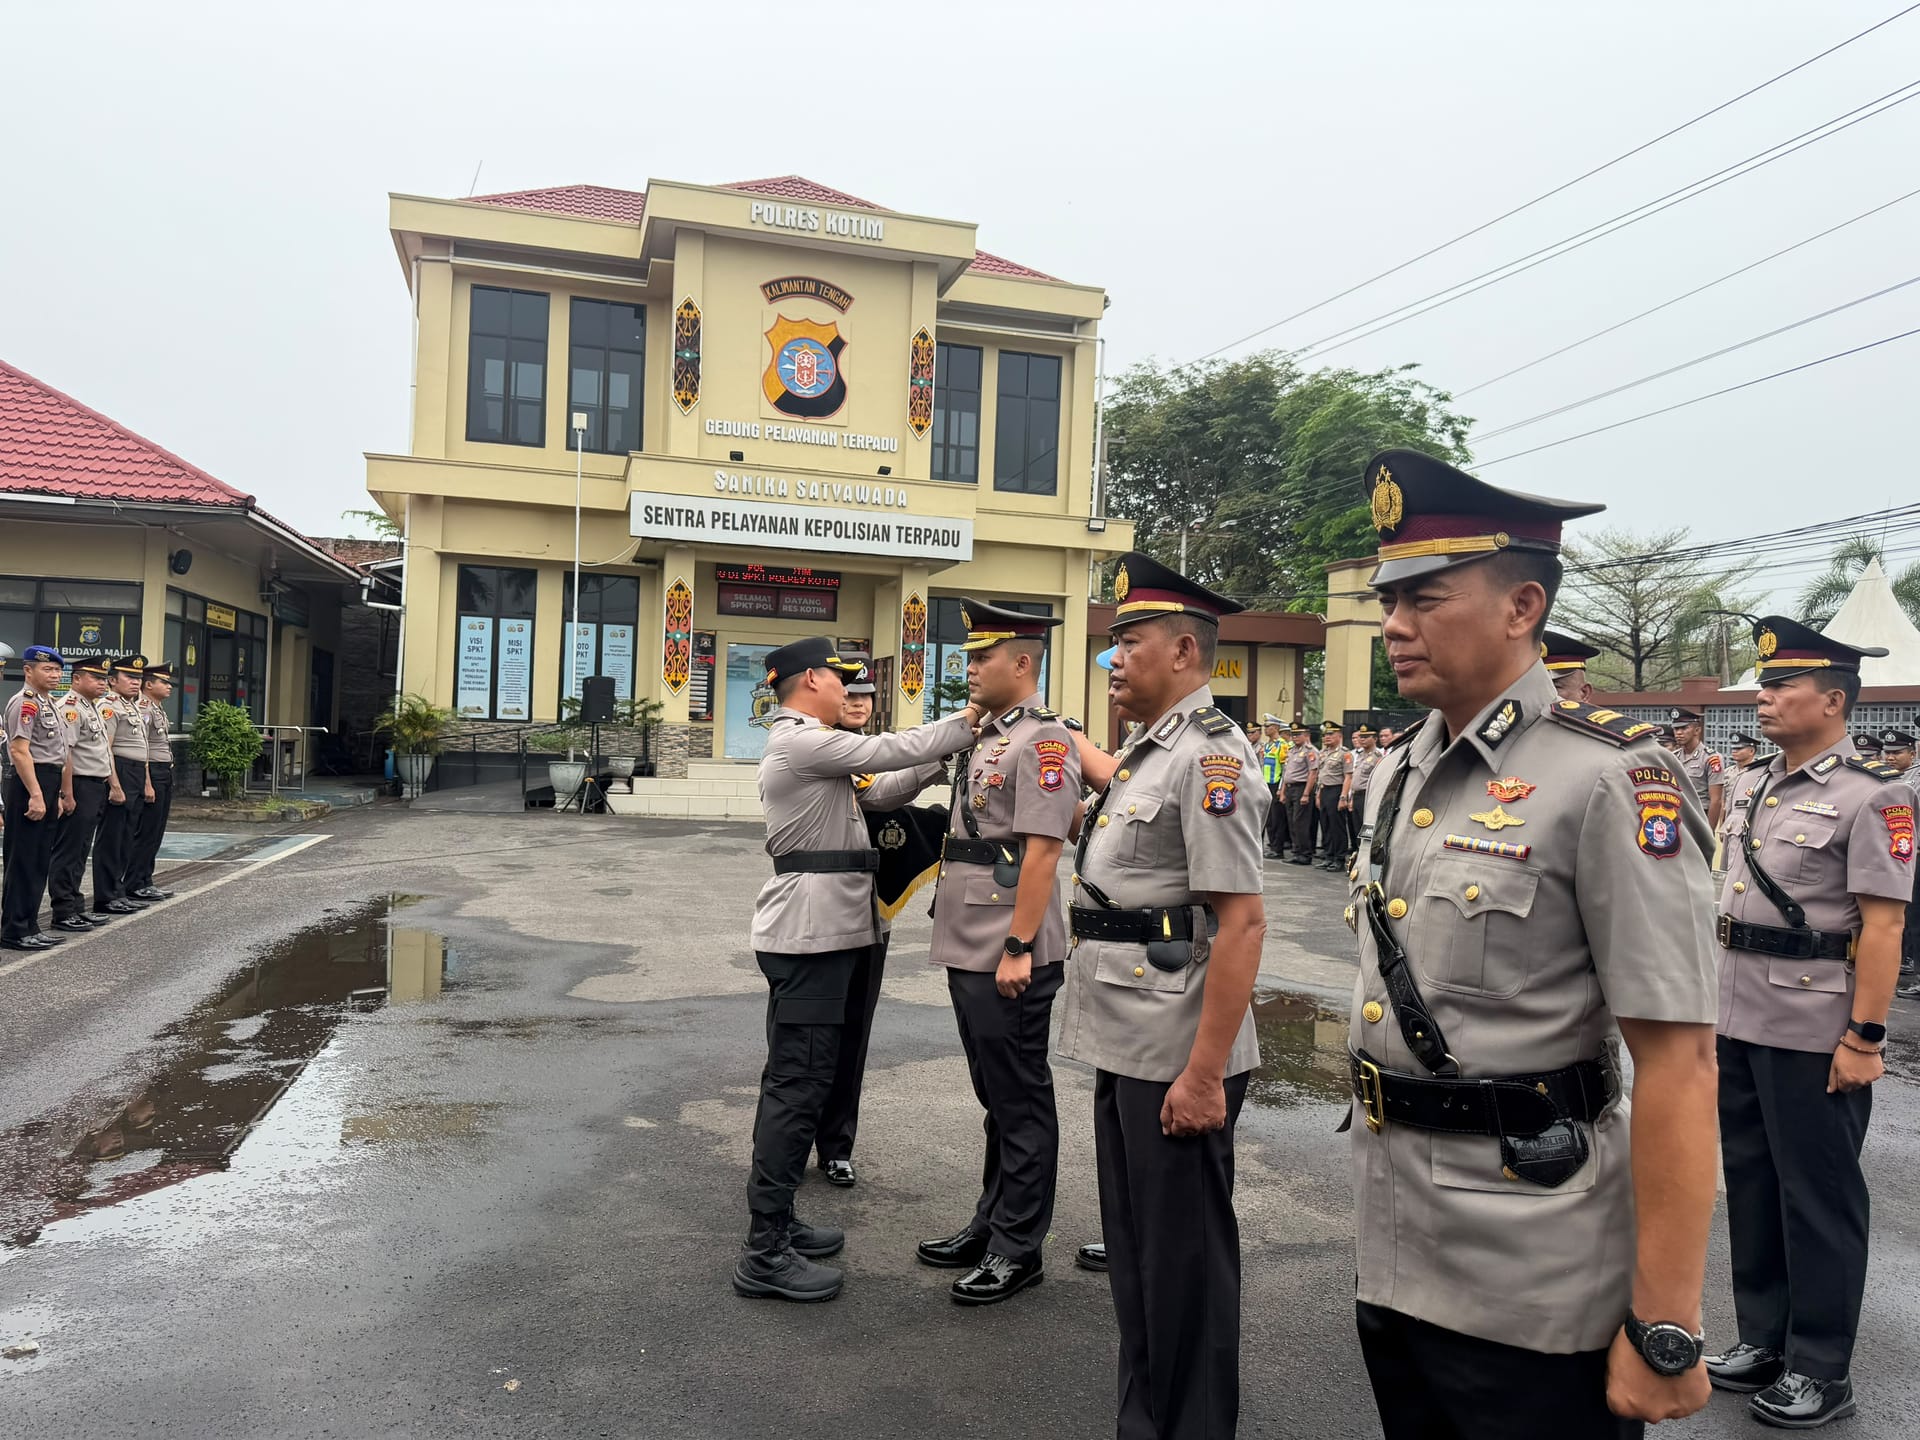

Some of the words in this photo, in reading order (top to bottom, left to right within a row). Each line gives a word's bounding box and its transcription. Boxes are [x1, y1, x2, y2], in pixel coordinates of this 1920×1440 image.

[751, 201, 819, 231] POLRES
[825, 212, 884, 240] KOTIM
[764, 280, 816, 299] KALIMANTAN
[818, 284, 850, 309] TENGAH
[706, 418, 760, 438] GEDUNG
[764, 425, 838, 447] PELAYANAN
[841, 433, 899, 453] TERPADU
[714, 470, 788, 497] SANIKA
[796, 480, 907, 508] SATYAWADA
[643, 505, 706, 529] SENTRA
[711, 511, 799, 536] PELAYANAN
[804, 518, 891, 542] KEPOLISIAN
[895, 525, 960, 548] TERPADU
[733, 593, 772, 603] SELAMAT
[469, 637, 483, 645] VISI
[577, 642, 590, 650] OTO
[61, 647, 102, 656] BUDAYA
[104, 648, 133, 657] MALU
[1211, 658, 1243, 679] AN
[1038, 742, 1066, 752] POLRES
[1635, 769, 1677, 786] POLDA
